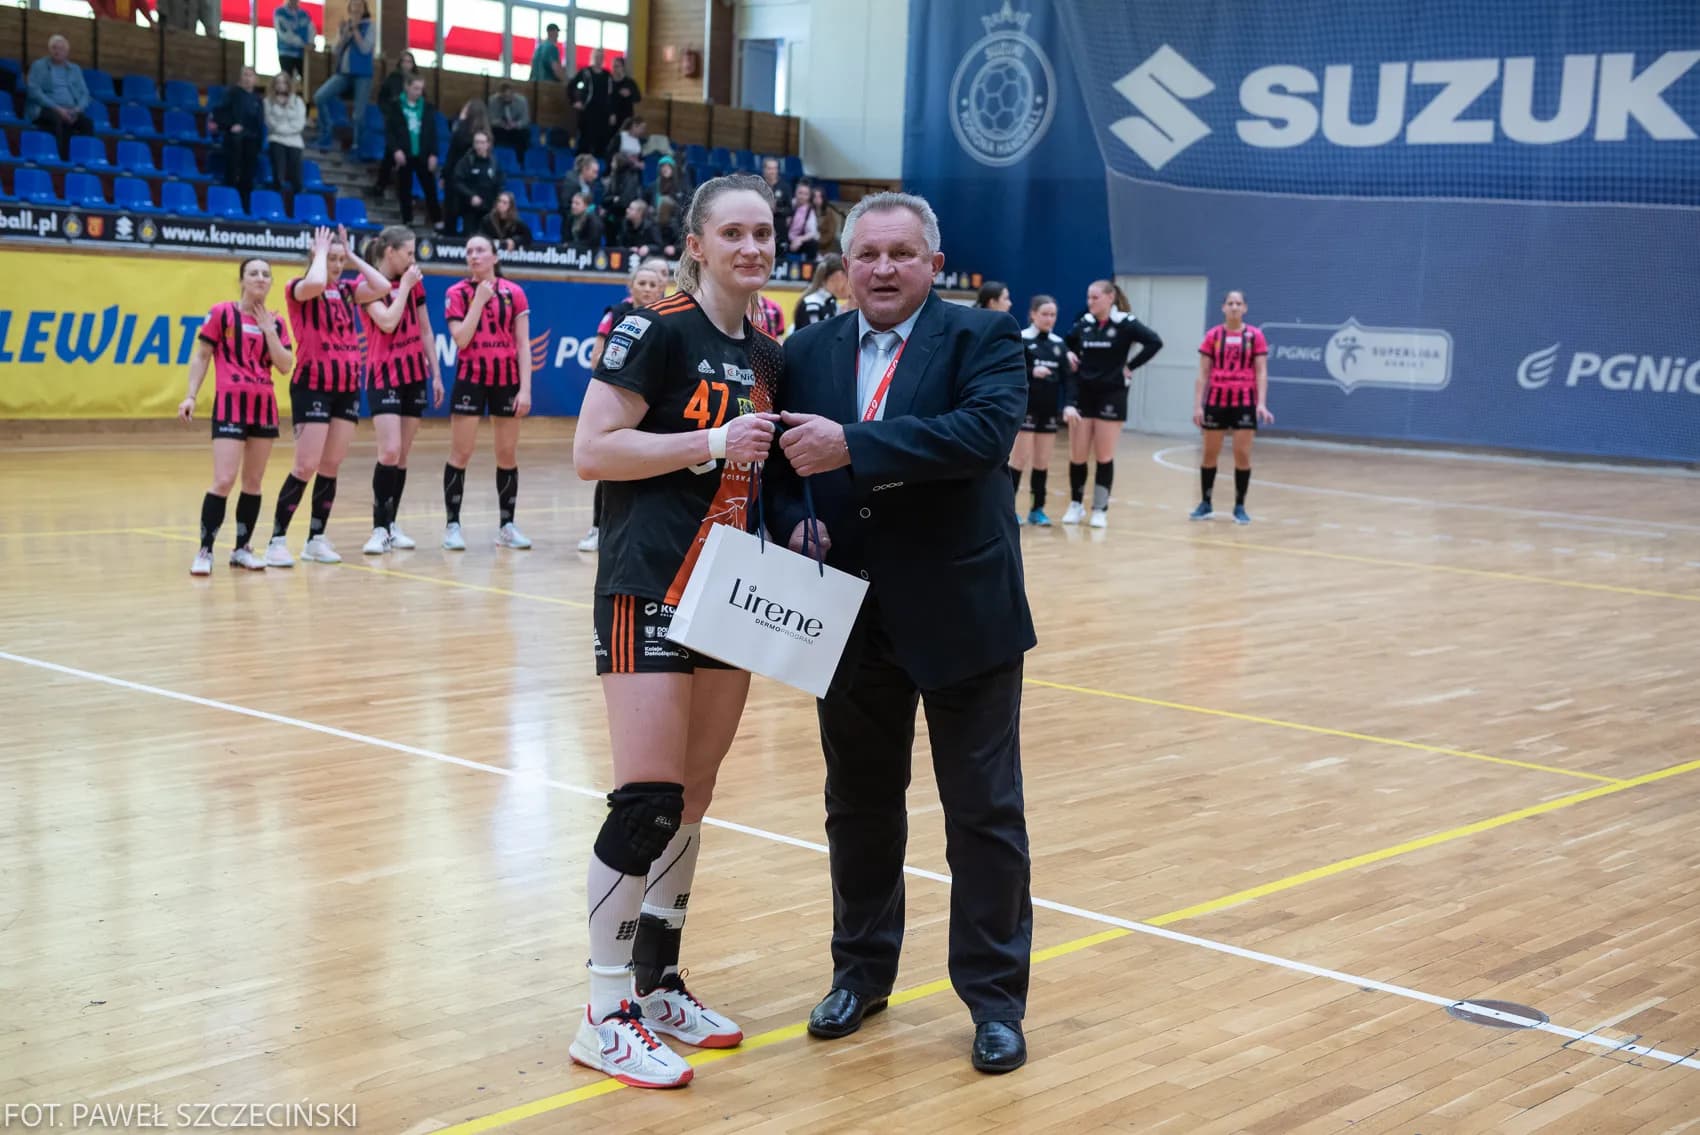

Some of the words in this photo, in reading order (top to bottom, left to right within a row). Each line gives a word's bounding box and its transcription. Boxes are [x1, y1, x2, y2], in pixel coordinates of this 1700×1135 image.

[1371, 346, 1441, 360] SUPERLIGA
[683, 379, 730, 429] 47
[728, 577, 824, 638] Lirene
